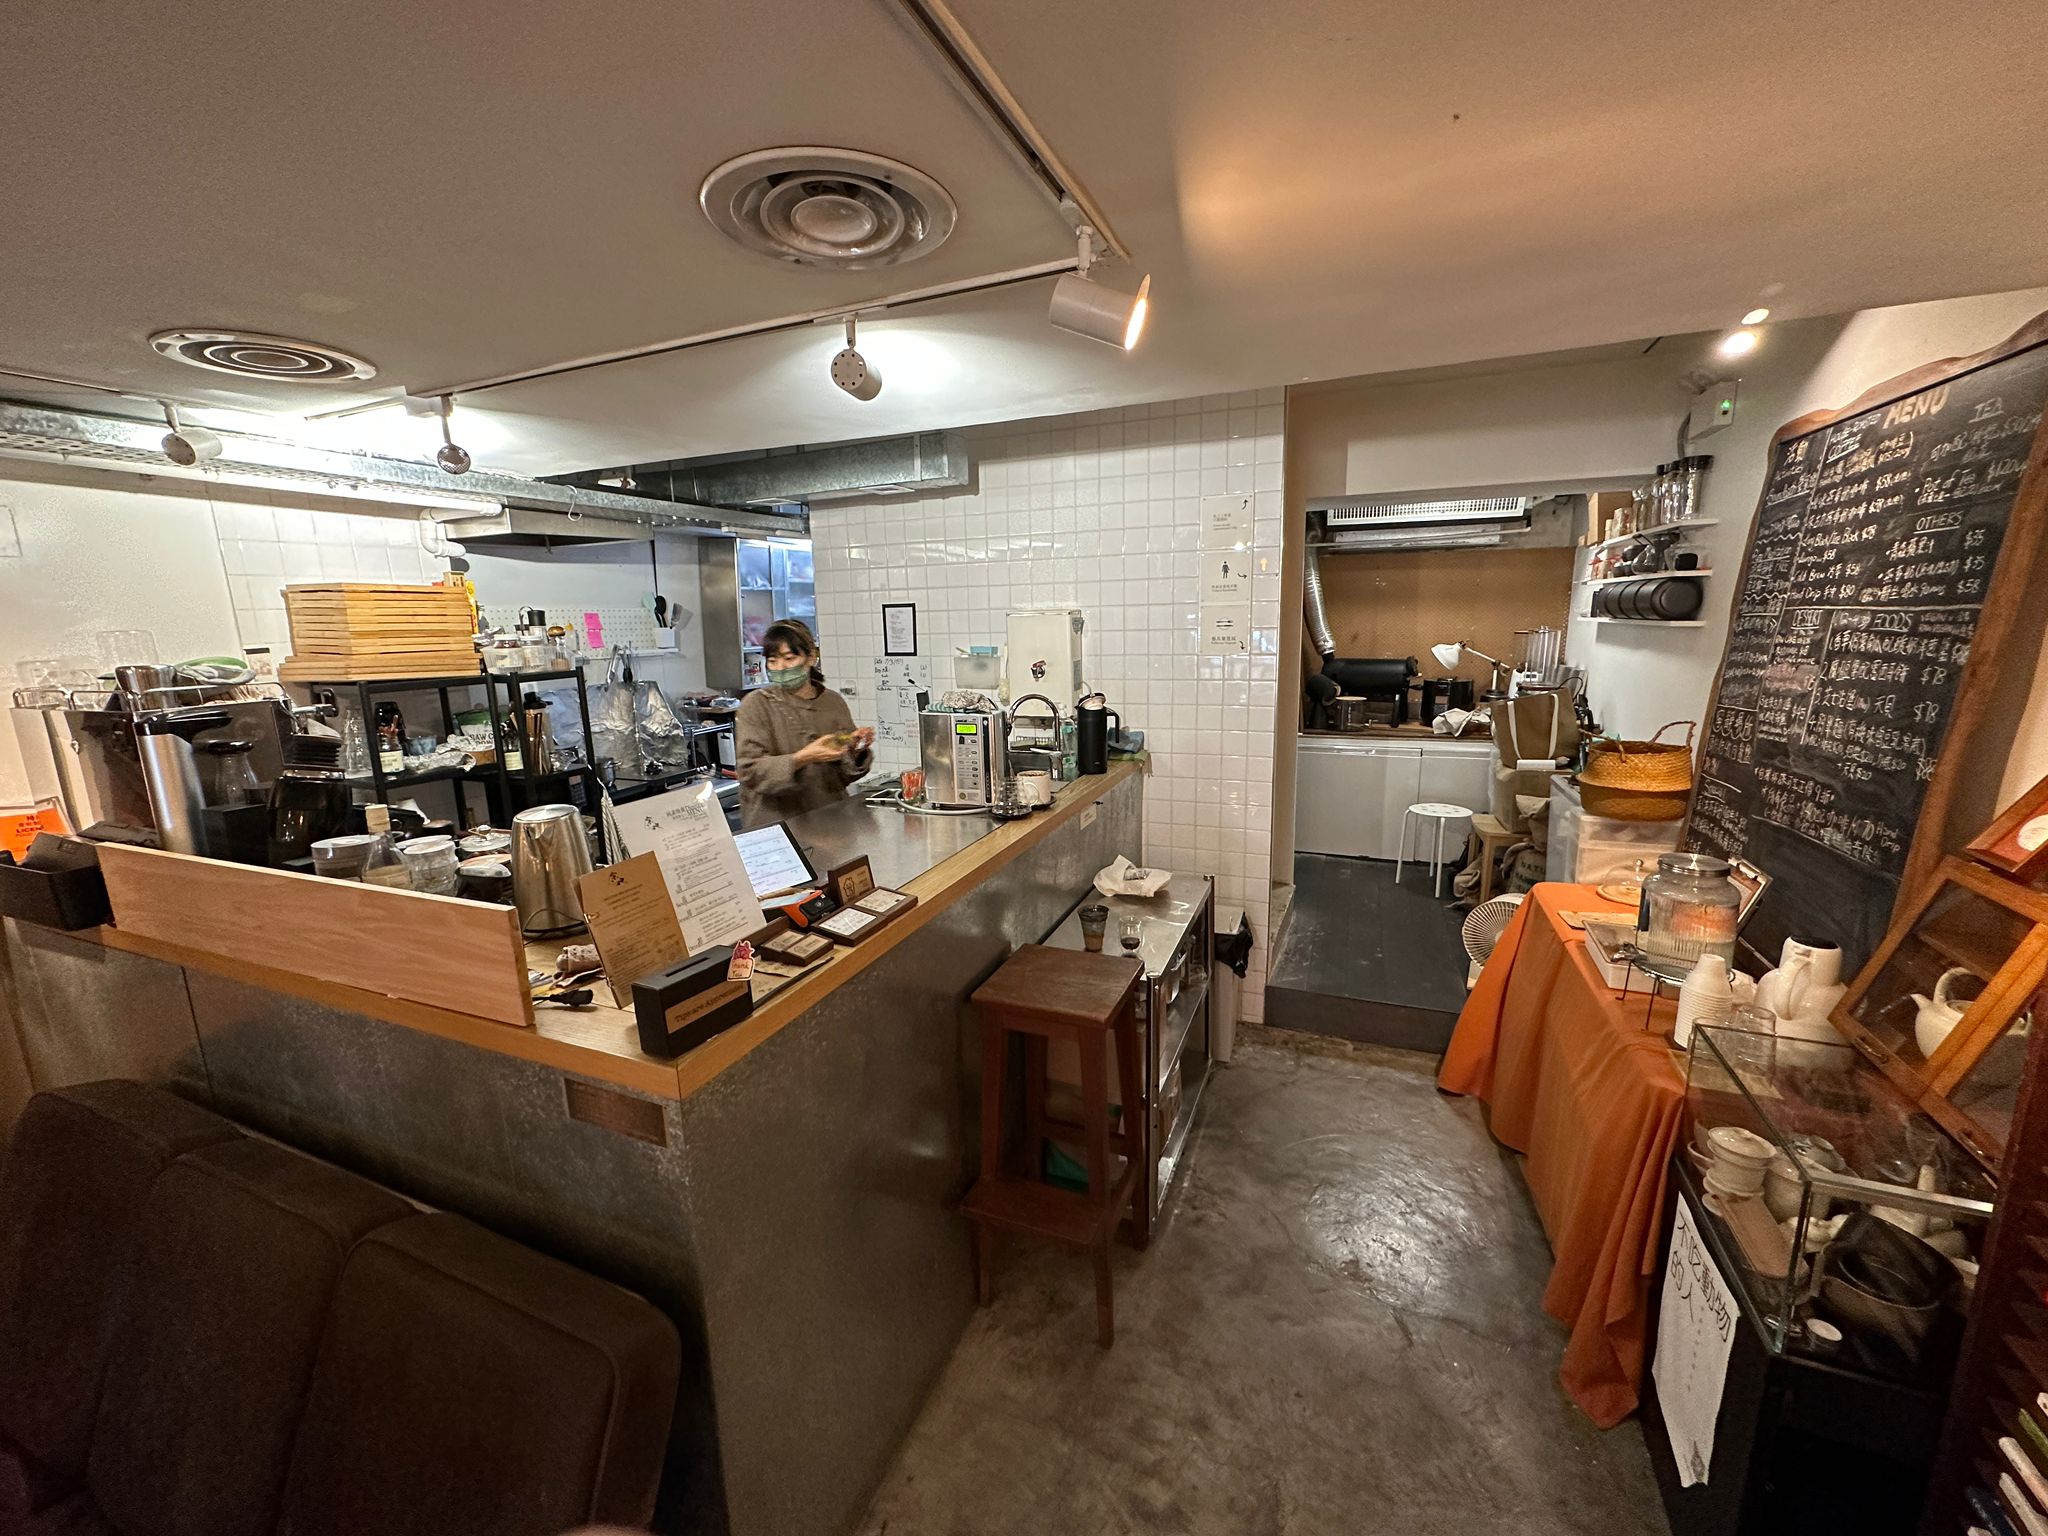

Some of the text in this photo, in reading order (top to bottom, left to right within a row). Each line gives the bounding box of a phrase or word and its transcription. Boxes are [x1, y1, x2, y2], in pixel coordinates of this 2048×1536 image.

[1882, 384, 1951, 429] MENU
[1974, 398, 2003, 420] TEA
[1828, 433, 1862, 459] COFFEE
[1923, 477, 1942, 494] Pot
[1942, 469, 1961, 489] of
[1960, 468, 1976, 487] Tea
[1916, 510, 1964, 531] OTHERS
[1809, 568, 1826, 581] Brew
[1957, 578, 1981, 594] $58
[1792, 609, 1822, 627] DESSERT
[1873, 611, 1915, 630] FOODS
[1920, 664, 1947, 685] $78
[1913, 700, 1940, 724] $78
[1670, 1250, 1695, 1324] 的人
[1677, 1209, 1732, 1343] 不吃動物
